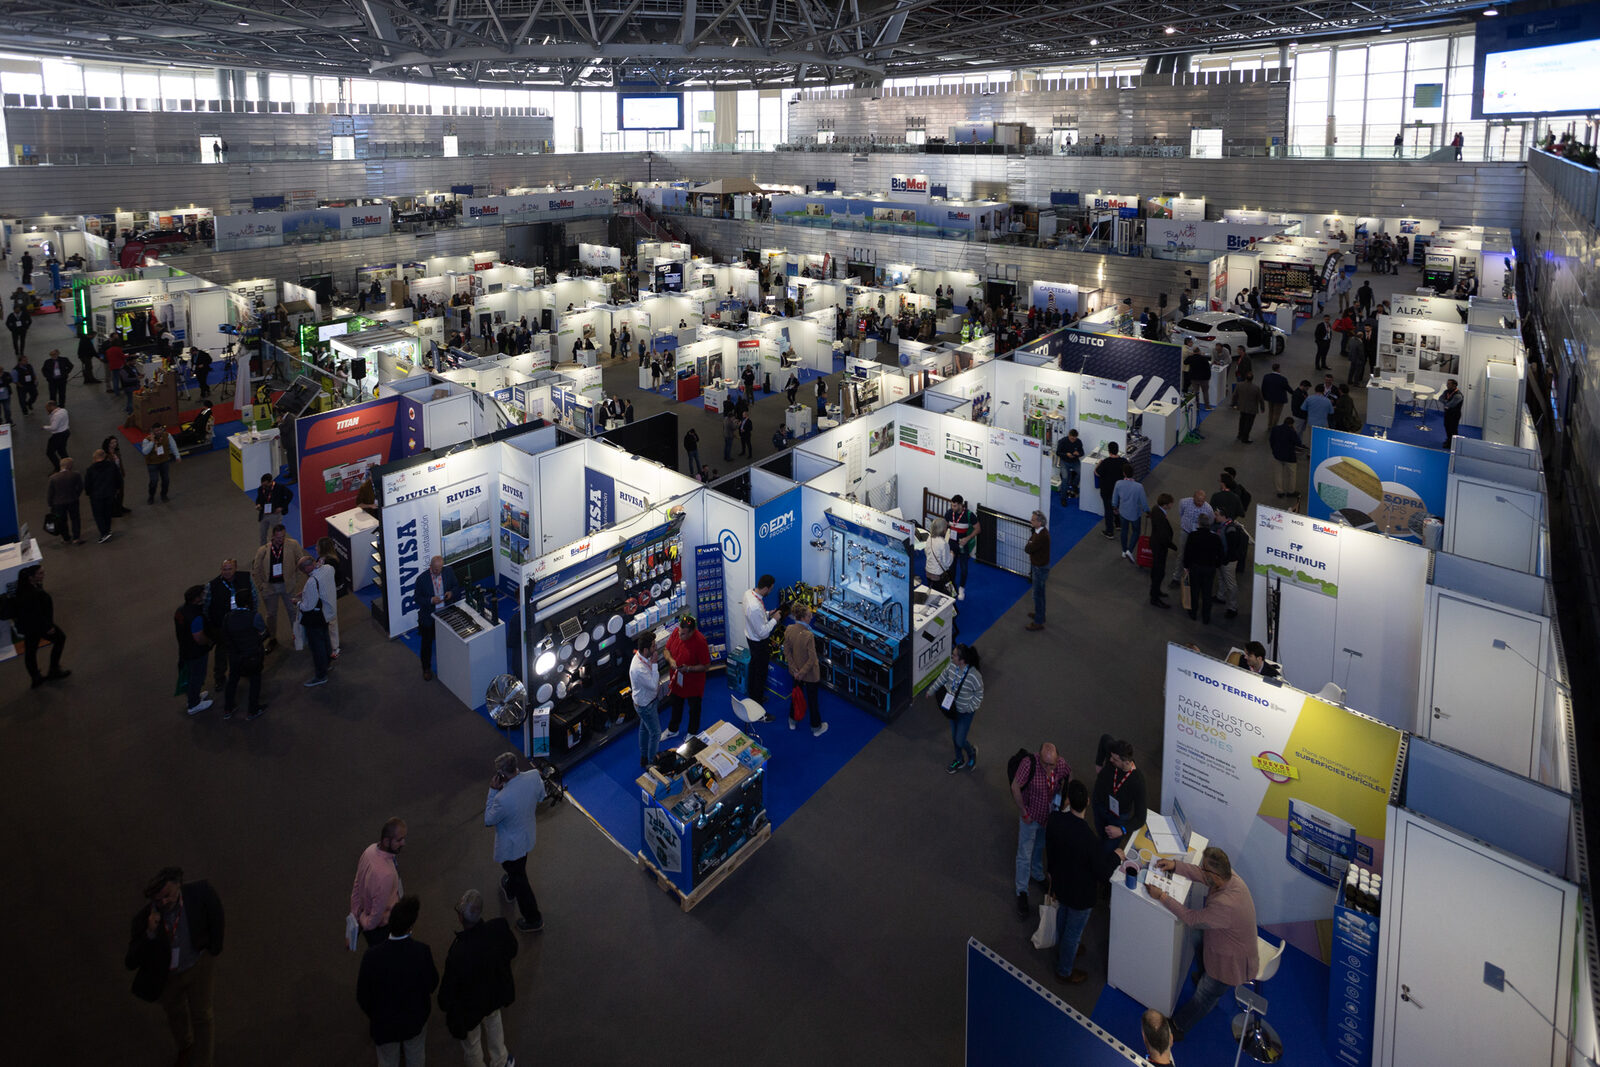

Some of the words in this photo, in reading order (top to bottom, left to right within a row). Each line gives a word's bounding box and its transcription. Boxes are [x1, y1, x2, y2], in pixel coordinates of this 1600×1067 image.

[891, 178, 927, 192] BigMat
[469, 205, 499, 217] BigMat
[549, 200, 575, 209] BigMat
[1094, 198, 1128, 209] BigMat
[352, 216, 382, 227] BigMat
[1396, 306, 1424, 316] ALFA
[1079, 335, 1105, 347] arco
[336, 416, 360, 430] TITAN
[446, 485, 482, 504] RIVISA
[502, 483, 524, 500] RIVISA
[619, 491, 643, 508] RIVISA
[1383, 494, 1424, 509] SOPRA
[769, 510, 794, 533] EDM
[1312, 523, 1338, 537] BigMat
[1266, 546, 1327, 571] PERFIMUR
[396, 518, 420, 617] RIVISA
[1192, 671, 1220, 688] TODO
[1221, 682, 1270, 707] TERRENO
[1178, 695, 1208, 713] PARA
[1211, 709, 1265, 738] GUSTOS,
[1178, 704, 1242, 737] NUESTROS
[1177, 714, 1227, 741] NUEVOS
[1176, 724, 1233, 753] COLORES
[1256, 758, 1290, 771] NUEVOS
[1295, 751, 1346, 778] SUPERFICIES
